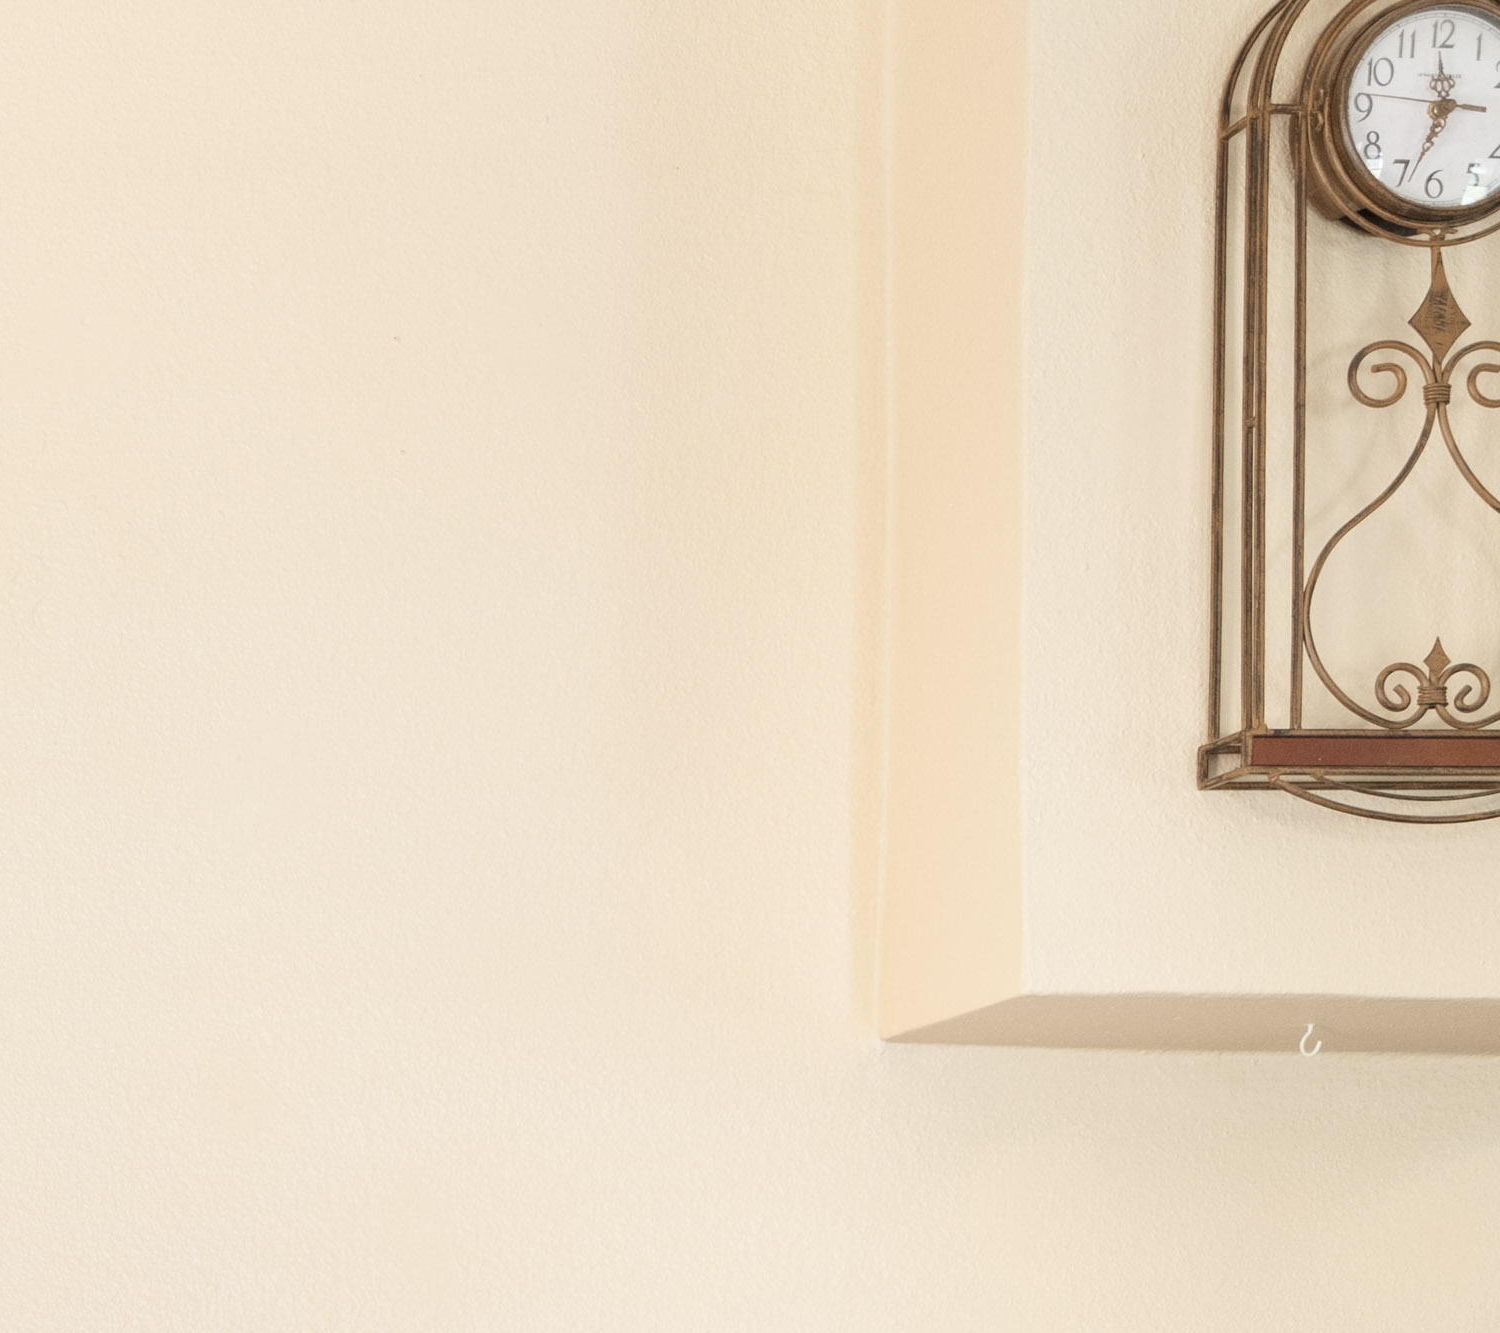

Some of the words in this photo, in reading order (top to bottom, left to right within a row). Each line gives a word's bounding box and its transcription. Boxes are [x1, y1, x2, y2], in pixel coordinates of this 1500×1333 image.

[1398, 29, 1416, 58] 11
[1431, 18, 1455, 48] 12
[1475, 32, 1483, 61] 1
[1367, 57, 1394, 86] 10
[1354, 92, 1373, 123] 9
[1364, 131, 1381, 160] 8
[1392, 159, 1411, 187] 7
[1425, 169, 1444, 198] 6
[1467, 163, 1481, 187] 5
